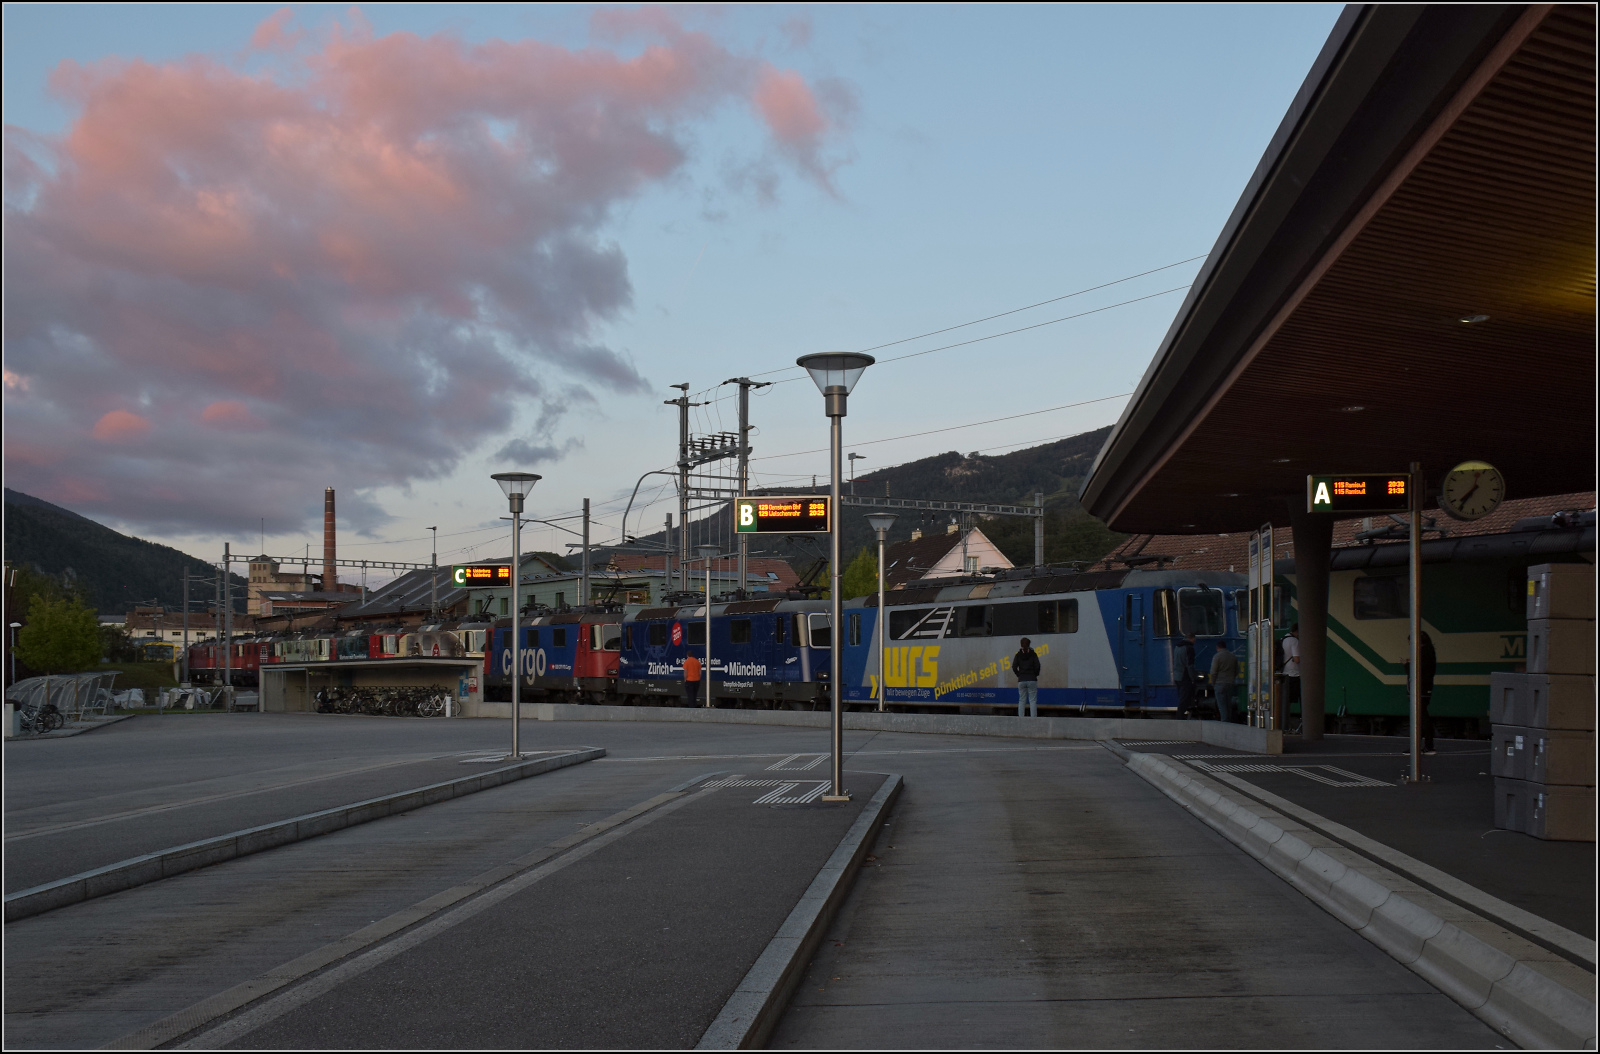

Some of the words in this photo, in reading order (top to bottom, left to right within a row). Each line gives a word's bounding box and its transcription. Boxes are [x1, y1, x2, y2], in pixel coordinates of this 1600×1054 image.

[1314, 482, 1330, 504] A
[740, 504, 753, 525] B
[455, 568, 464, 583] C
[502, 648, 546, 685] crgo
[648, 662, 669, 675] Zürich
[729, 662, 766, 676] München
[934, 670, 977, 700] pünktlich
[979, 662, 998, 680] seit
[1000, 656, 1011, 671] 15
[895, 688, 917, 697] bewegen
[917, 688, 930, 697] Züge
